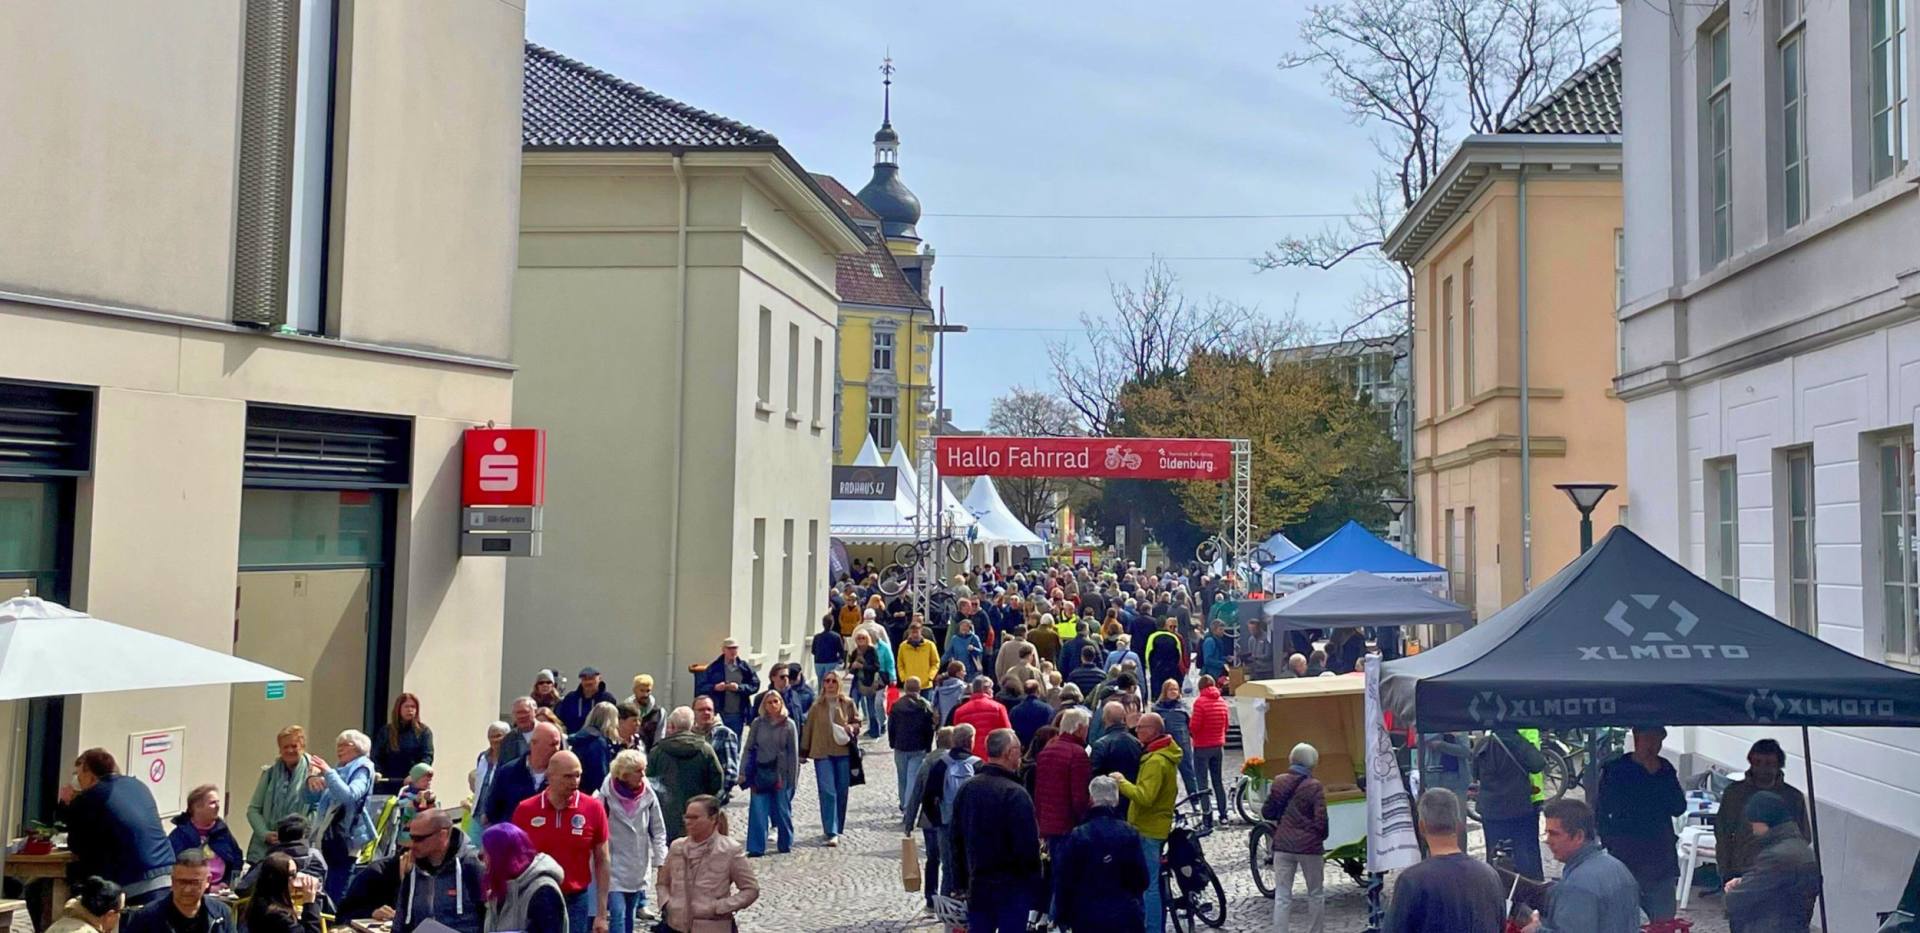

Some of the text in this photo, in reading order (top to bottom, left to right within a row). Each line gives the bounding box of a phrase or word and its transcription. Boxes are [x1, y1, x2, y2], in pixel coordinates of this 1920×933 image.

[947, 447, 1090, 469] Hallo Fahrrad
[1159, 457, 1214, 473] Oldenburg
[839, 482, 875, 495] RADHAUS
[487, 515, 526, 524] -Service
[1577, 644, 1750, 661] XLMOTO
[1509, 696, 1617, 718] XLMOTO
[1788, 698, 1896, 717] XLMOTO
